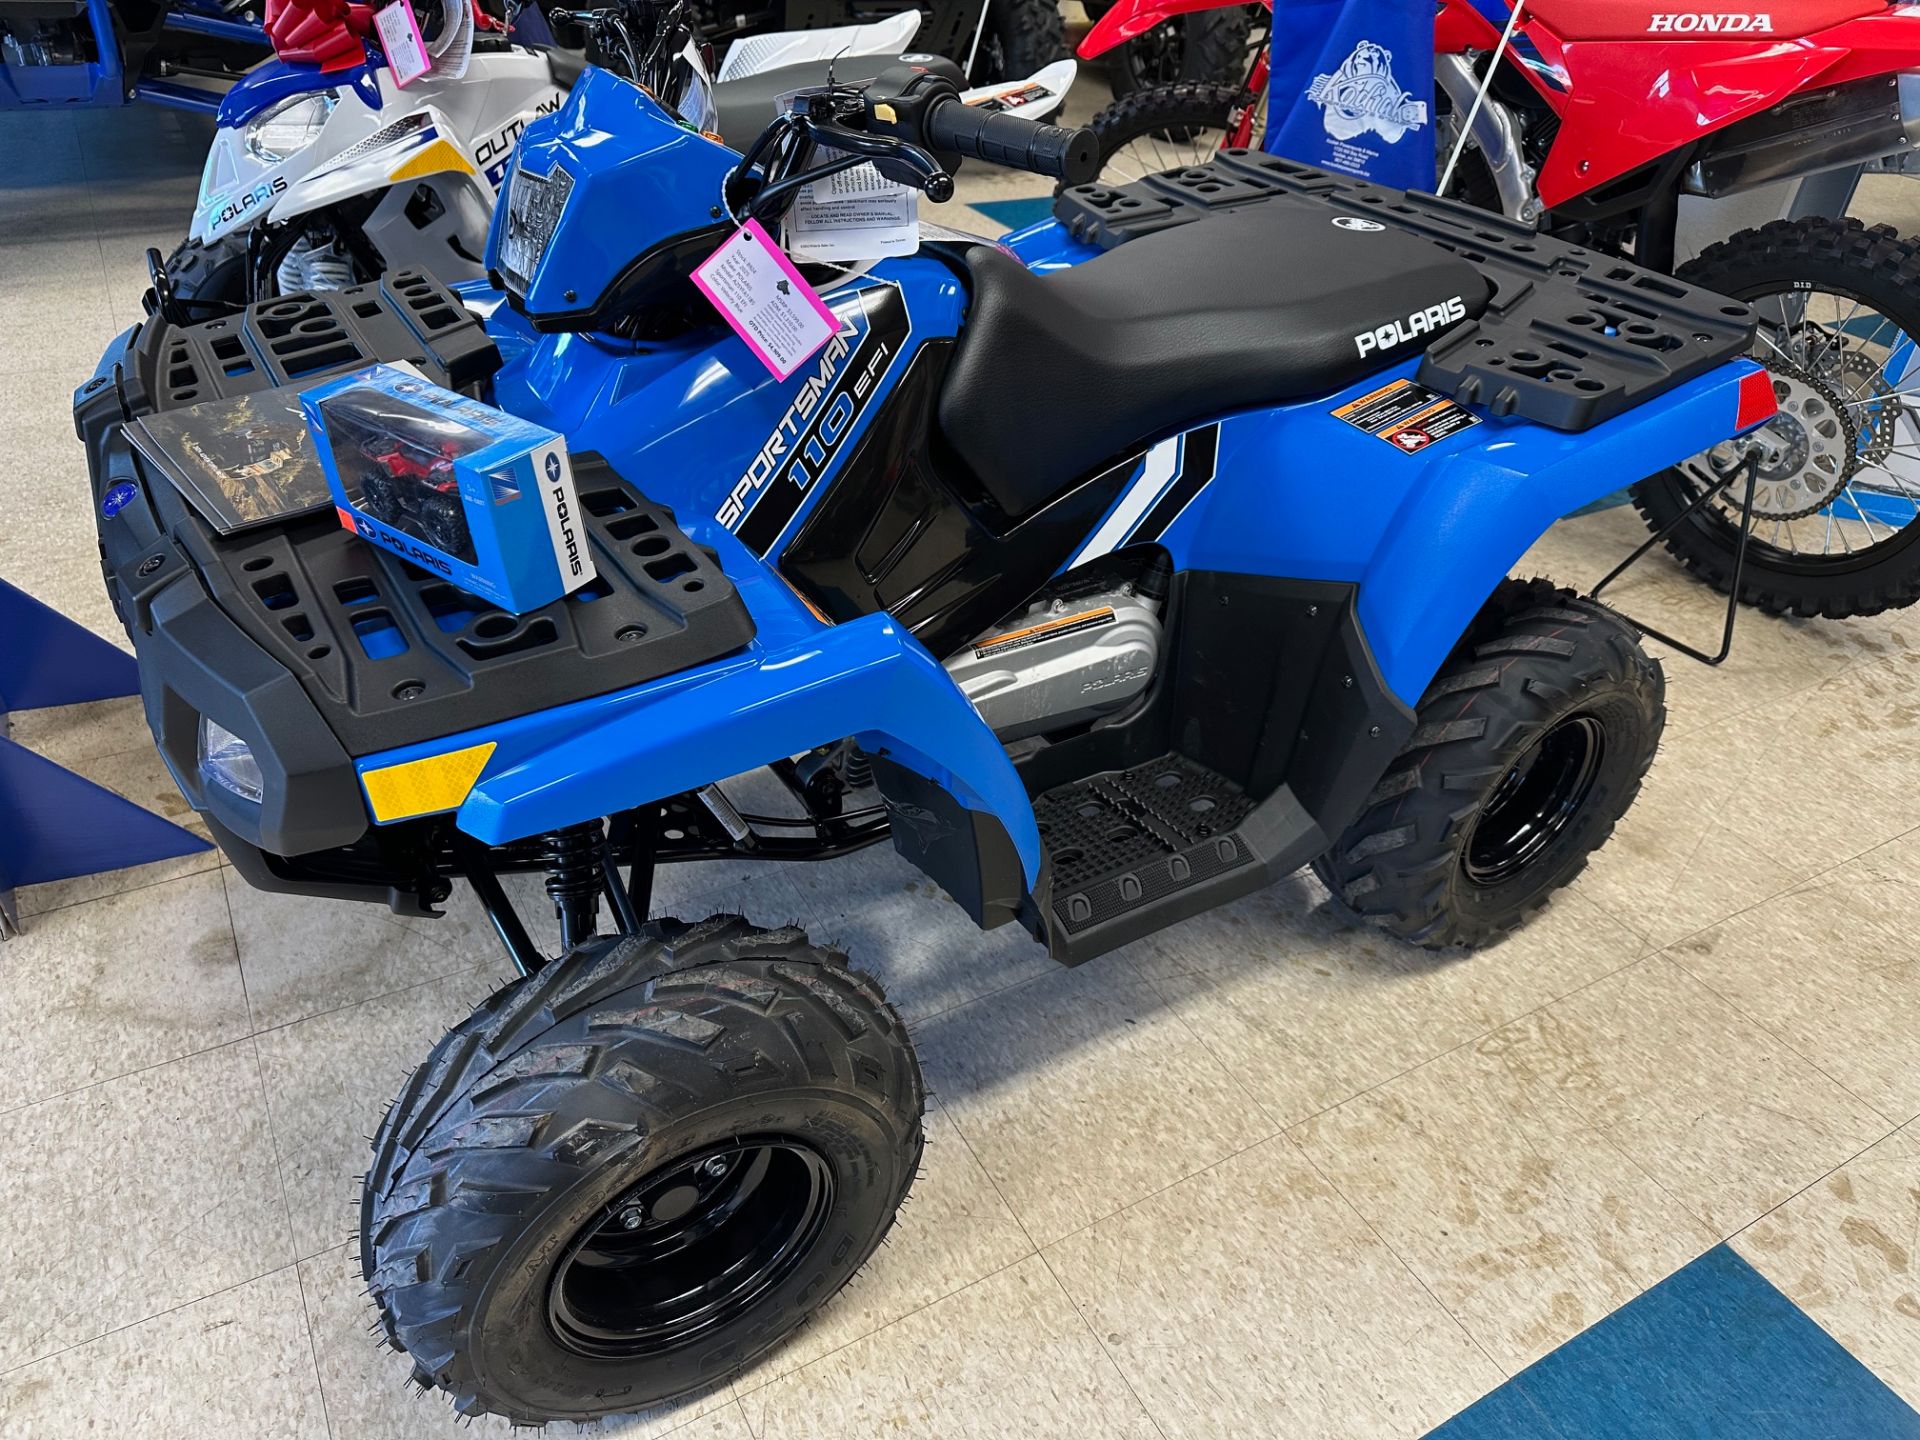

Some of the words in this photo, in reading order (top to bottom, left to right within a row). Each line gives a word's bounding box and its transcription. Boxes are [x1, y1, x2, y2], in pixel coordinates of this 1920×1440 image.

[1646, 13, 1774, 33] HONDA
[213, 176, 287, 230] POLARIS
[714, 268, 735, 292] Sportsman
[733, 290, 742, 300] 110
[739, 298, 748, 307] EFI
[735, 271, 752, 291] POLARIS
[733, 302, 743, 314] Blue
[1353, 295, 1467, 359] POLARIS
[748, 319, 759, 332] OTD
[756, 329, 769, 344] Price:
[1359, 386, 1393, 405] WARNING
[714, 313, 859, 530] SPORTSMAN
[787, 391, 854, 491] 110
[853, 342, 889, 399] EFI
[552, 486, 583, 577] POLARIS
[379, 530, 454, 576] POLARIS
[1080, 666, 1149, 695] POLARIS
